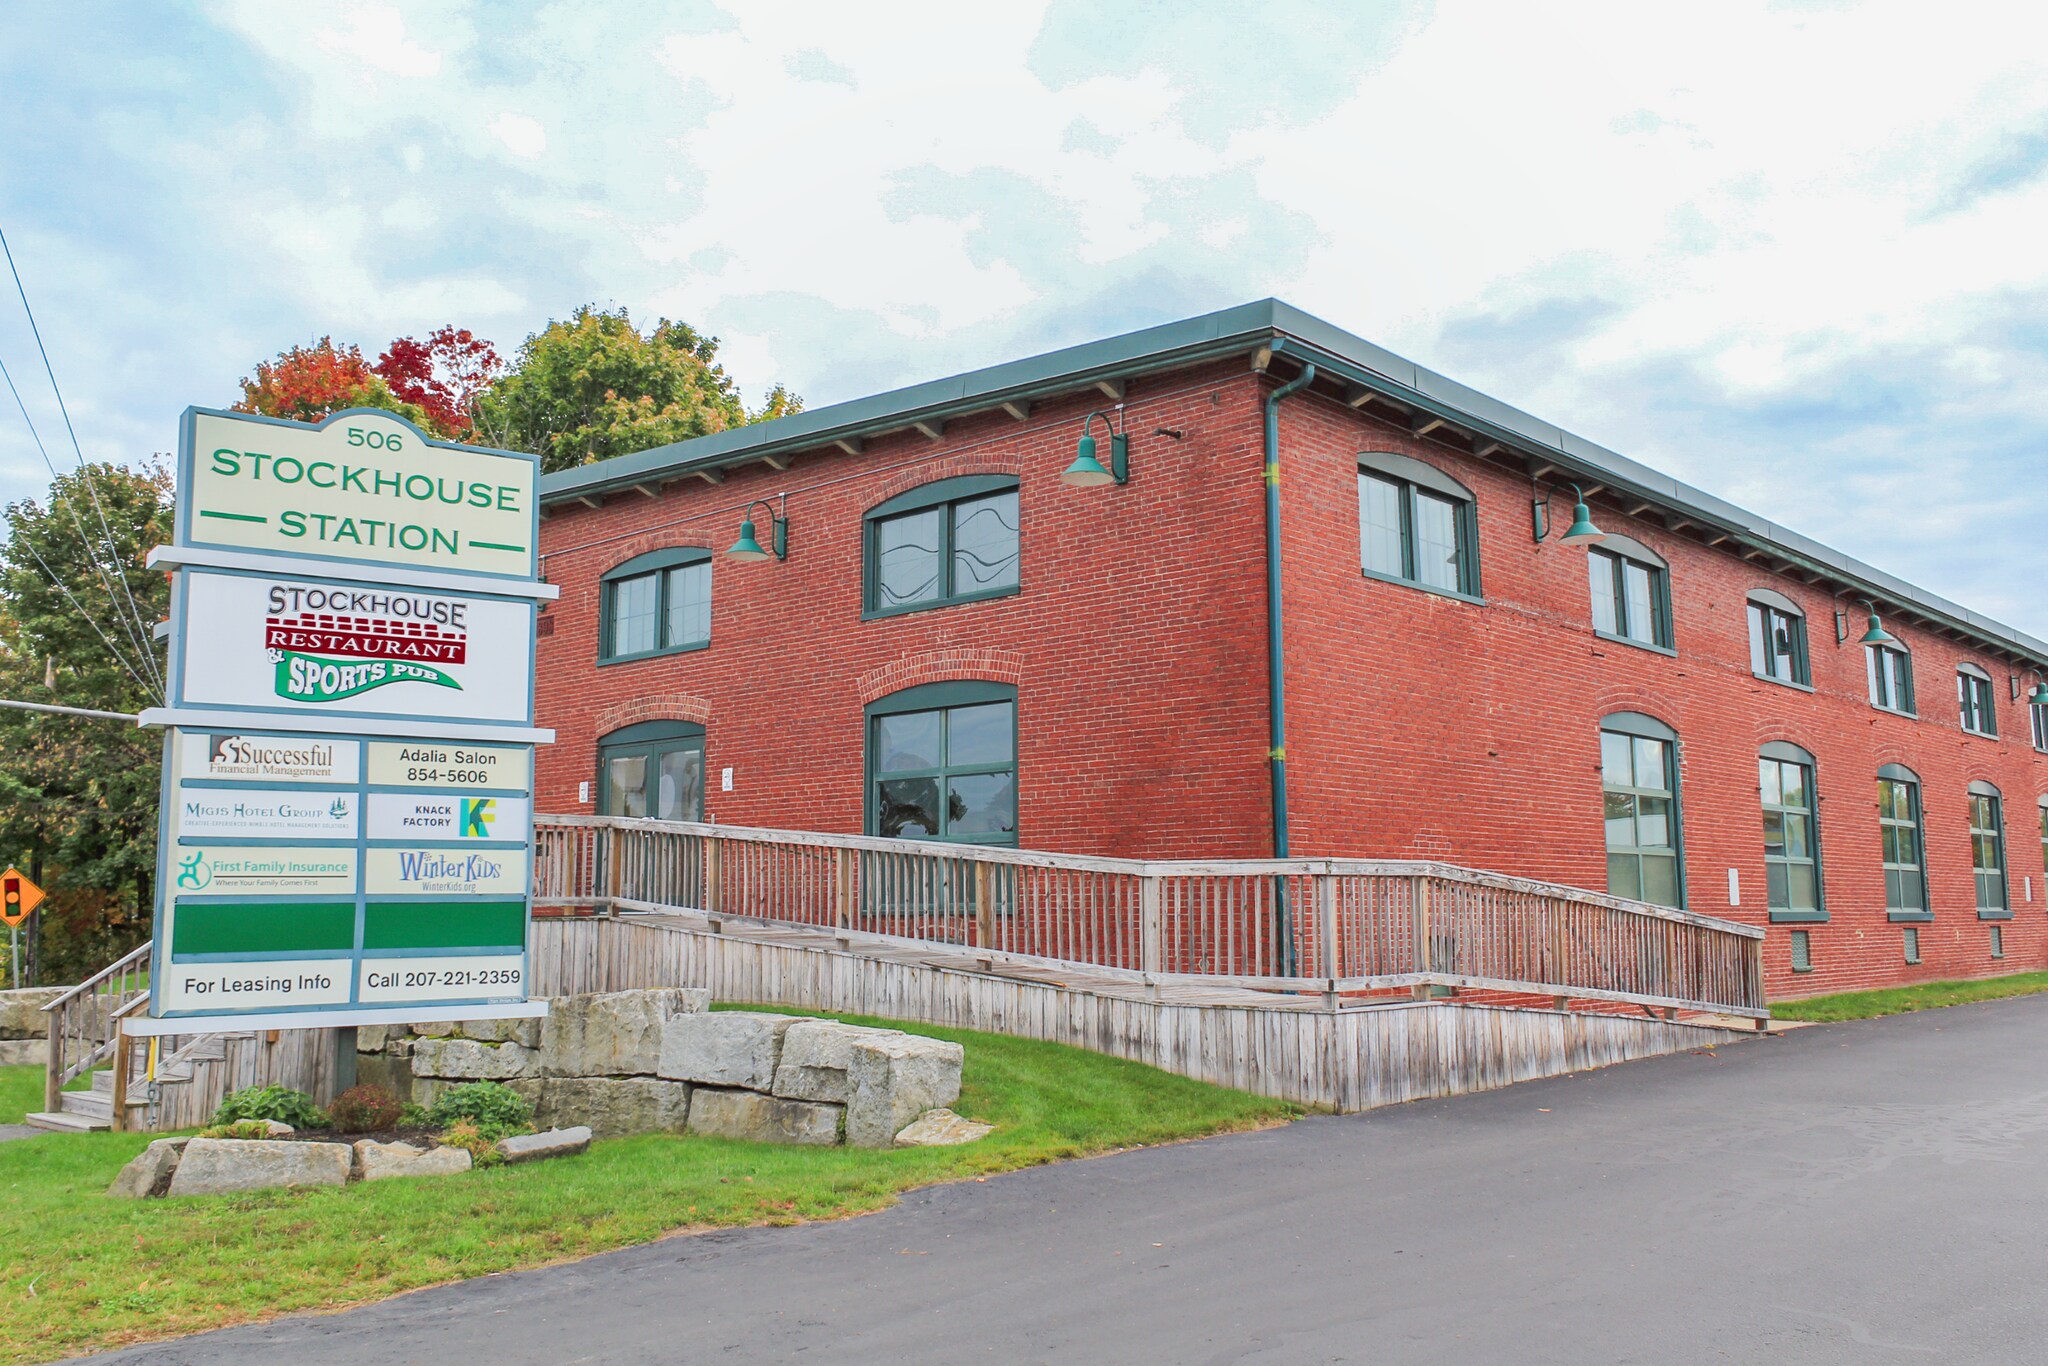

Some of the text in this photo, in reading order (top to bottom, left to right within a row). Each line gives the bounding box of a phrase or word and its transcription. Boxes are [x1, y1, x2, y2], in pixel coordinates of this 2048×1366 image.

[347, 427, 403, 452] 506
[210, 448, 521, 512] STOCKHOUSE
[278, 510, 460, 555] STATION
[268, 586, 467, 631] STOCKHOUSE
[269, 630, 462, 659] RESTAURANT
[267, 647, 440, 696] & SPORTS PUB
[241, 742, 332, 766] Successful
[400, 748, 497, 765] Adalia Salon
[210, 763, 331, 777] Financial Management
[407, 768, 488, 783] 854-5606
[233, 803, 274, 818] HOTEL
[279, 804, 323, 818] GROUP
[415, 806, 452, 815] KNACK
[403, 817, 452, 827] FACTORY
[213, 861, 348, 874] First Family Insurance
[257, 879, 278, 888] Family
[422, 882, 476, 893] WinterKids.org
[185, 974, 331, 994] For Leasing Info
[367, 970, 521, 988] Call 207-221-2359
